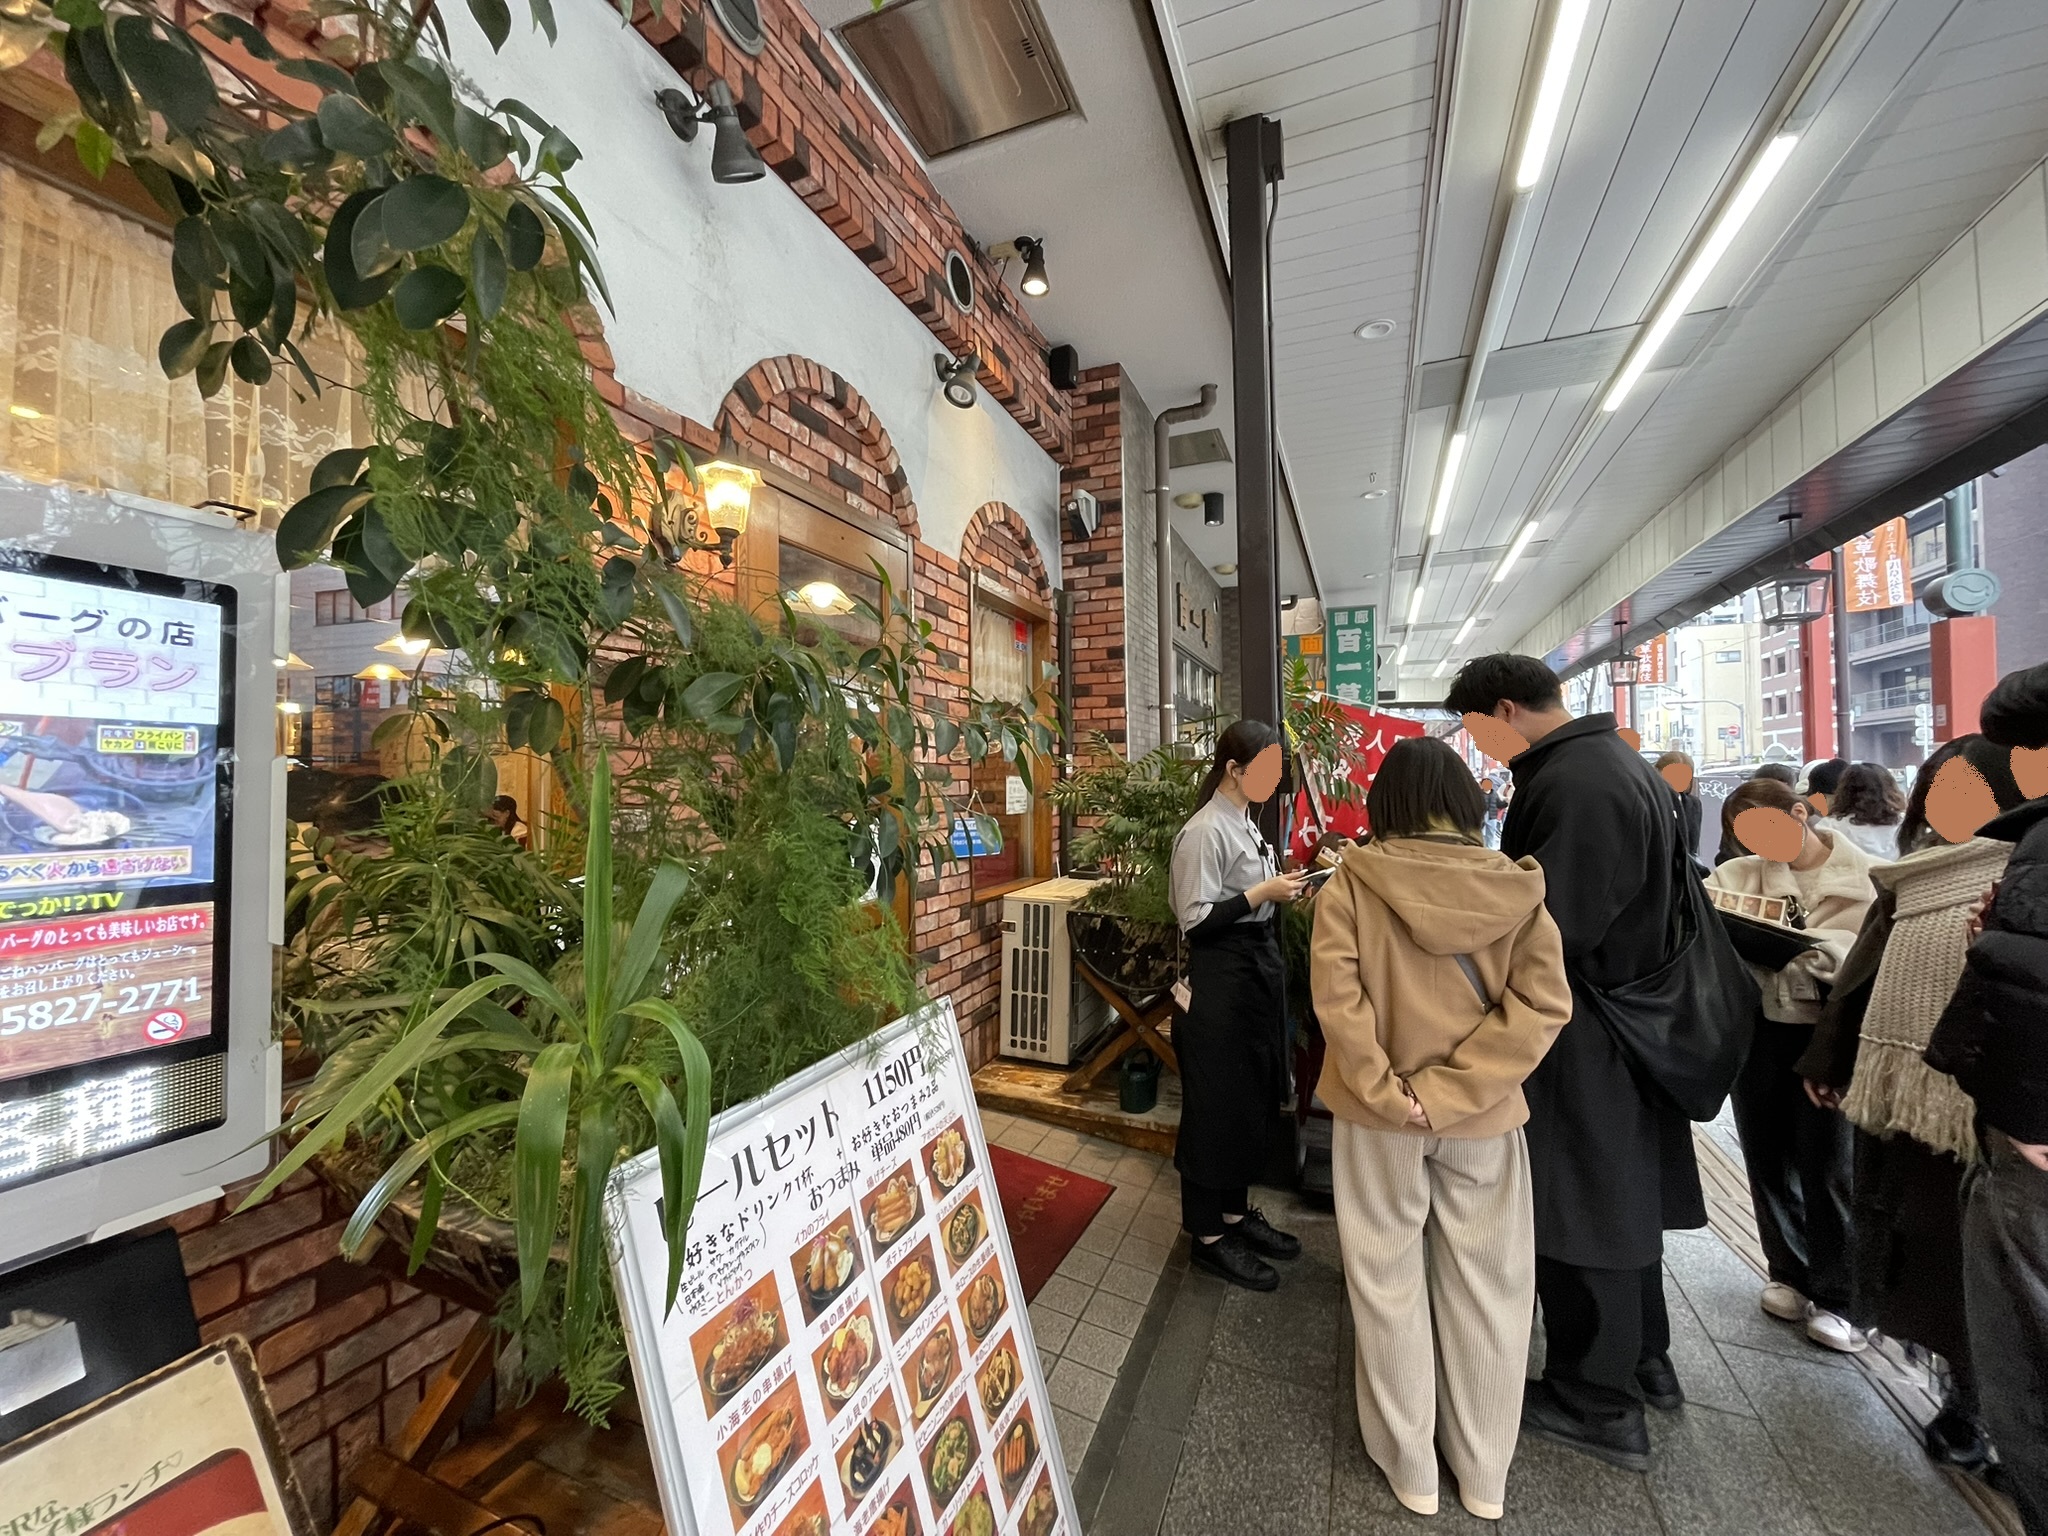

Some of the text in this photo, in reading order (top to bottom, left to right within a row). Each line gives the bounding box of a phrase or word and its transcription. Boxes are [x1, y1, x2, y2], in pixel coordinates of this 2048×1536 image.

[0, 596, 195, 647] ーグの店
[1334, 610, 1369, 626] 画廊
[11, 640, 197, 692] ブラン
[0, 913, 206, 951] バーグのとっても美味しいお店です。
[1, 977, 201, 1036] 5827-2771
[860, 1044, 926, 1109] 1150円
[869, 1111, 921, 1163] 単品480円
[808, 1159, 861, 1211] おつまみ
[793, 1208, 831, 1245] イカのフライ
[885, 1230, 920, 1269] ポテトフライ
[818, 1287, 860, 1336] 鶏の唐揚げ
[896, 1294, 950, 1361] ミニサーロインステーキ
[716, 1356, 794, 1443] 小海老の串揚げ
[748, 1453, 819, 1536] 作りチーズコロッケ
[940, 1459, 986, 1528] ガーリックトースト
